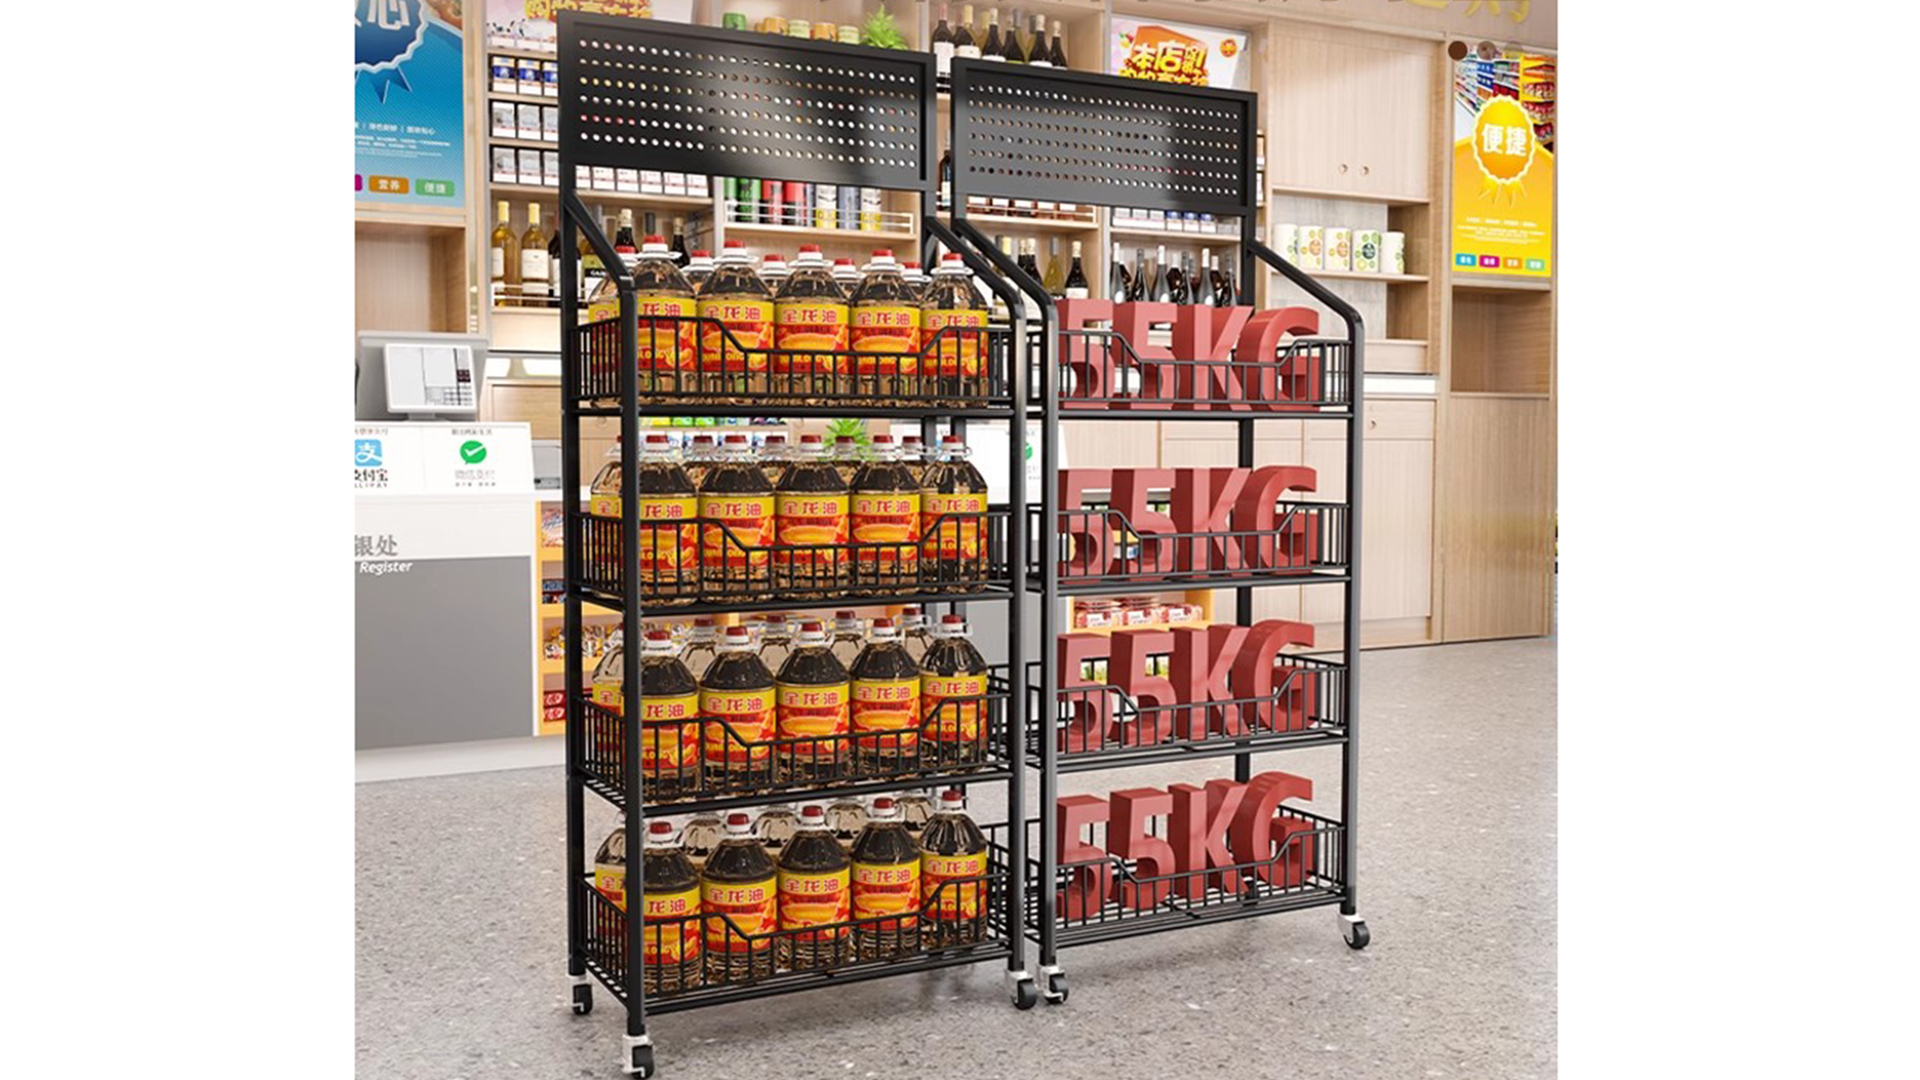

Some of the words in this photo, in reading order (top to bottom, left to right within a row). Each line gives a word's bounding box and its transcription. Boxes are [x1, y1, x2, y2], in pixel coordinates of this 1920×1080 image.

[1482, 123, 1527, 157] 便捷
[1057, 299, 1319, 412] 55KG
[359, 561, 413, 576] Register
[1058, 466, 1317, 584] 55KG
[1057, 619, 1315, 753] 55KG
[1056, 771, 1313, 921] 55KG
